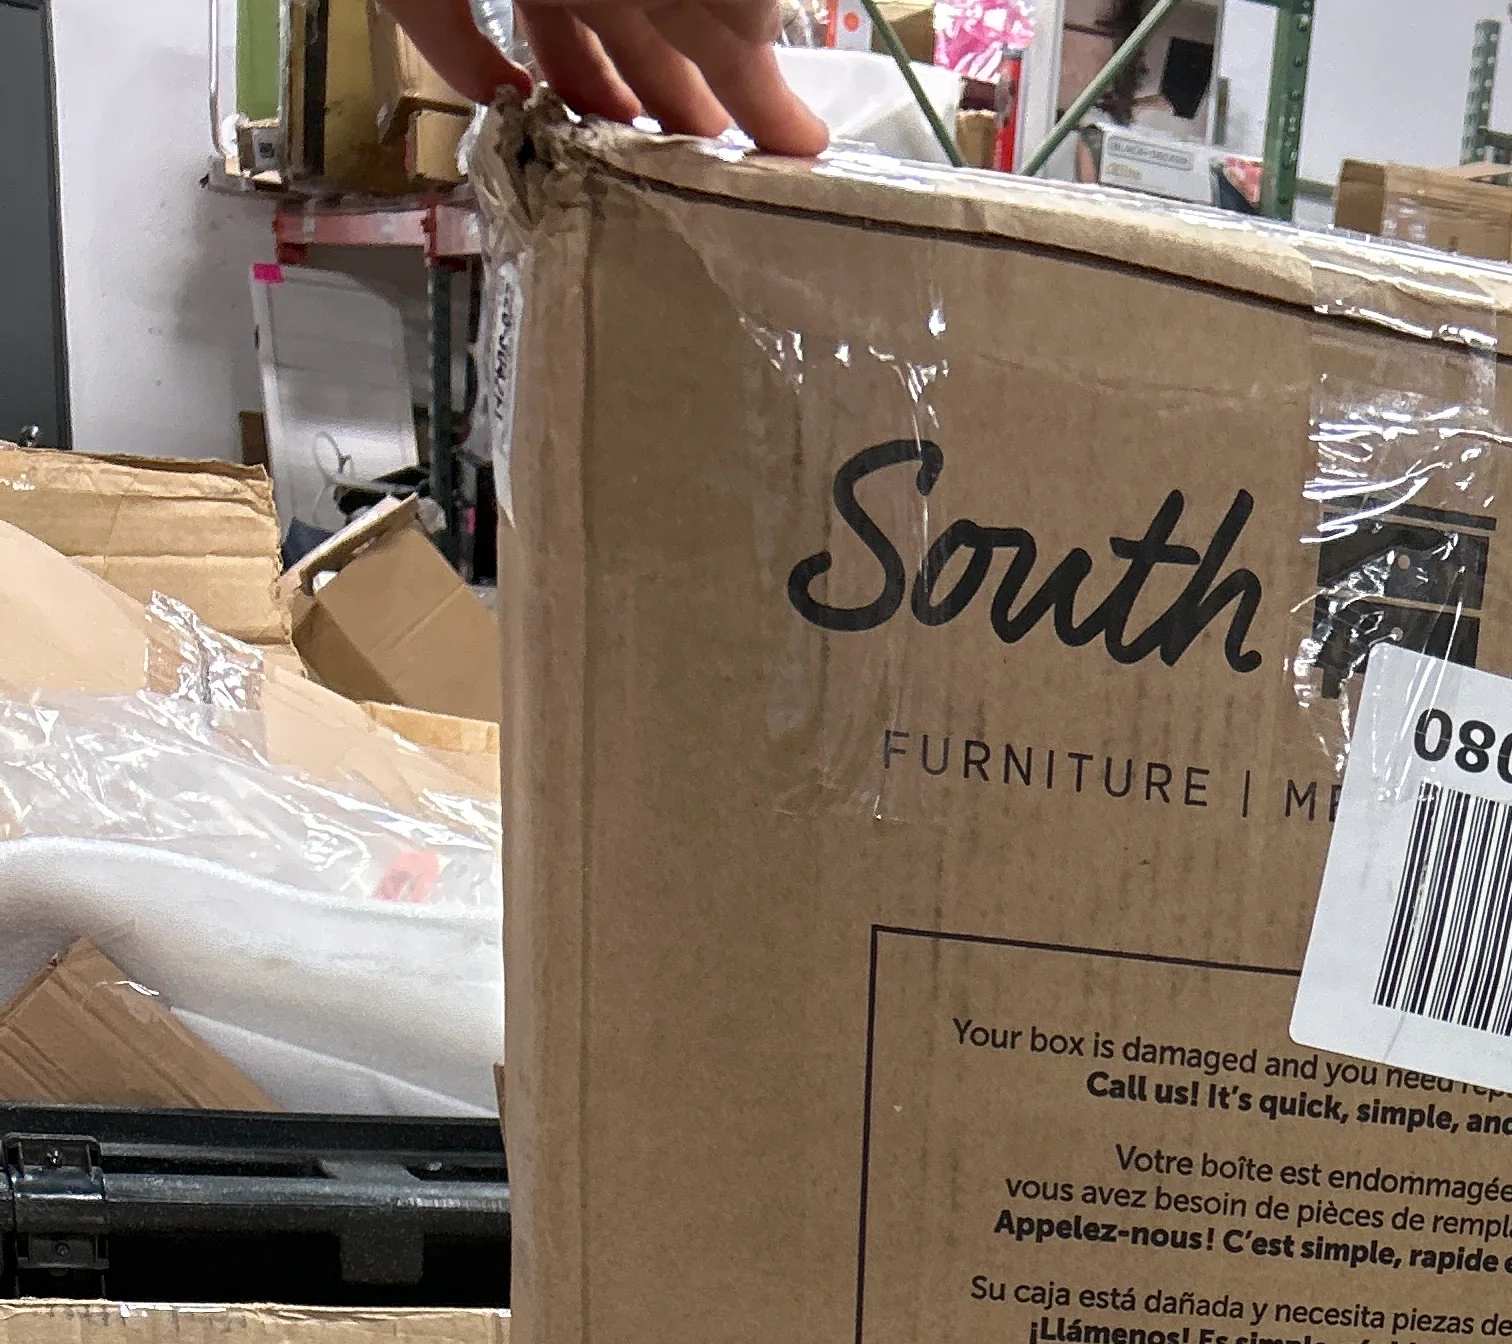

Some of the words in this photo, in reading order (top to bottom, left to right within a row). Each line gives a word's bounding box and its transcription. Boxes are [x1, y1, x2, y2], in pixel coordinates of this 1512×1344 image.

[786, 440, 1263, 675] South
[884, 730, 1210, 806] FURNITURE
[953, 1017, 1022, 1049] Your
[1030, 1025, 1084, 1056] box
[1093, 1031, 1114, 1058] is
[1122, 1035, 1257, 1075] damaged
[1264, 1049, 1318, 1080] and
[1324, 1061, 1377, 1088] you
[1086, 1071, 1147, 1101] Call
[1155, 1080, 1199, 1106] us!
[1208, 1083, 1252, 1111] It's
[1259, 1091, 1348, 1124] quick,
[1356, 1098, 1459, 1133] simple,
[1115, 1143, 1193, 1175] Votre
[1201, 1152, 1273, 1182] boîte
[1279, 1163, 1322, 1186] est
[1004, 1180, 1072, 1203] vous
[1081, 1187, 1146, 1208] avez
[1154, 1186, 1246, 1216] besoin
[1255, 1194, 1289, 1220] de
[1296, 1199, 1383, 1228] pièces
[1391, 1206, 1424, 1231] de
[993, 1209, 1214, 1250] Appelez-nous!
[1222, 1229, 1294, 1257] C'est
[1300, 1235, 1401, 1268] simple,
[1409, 1246, 1498, 1274] rapide
[970, 1275, 1005, 1301] Su
[1014, 1281, 1070, 1310] caja
[1078, 1287, 1135, 1310] está
[1144, 1289, 1243, 1318] dañada
[1249, 1302, 1268, 1325] y
[1275, 1303, 1384, 1328] necesita
[1391, 1307, 1474, 1335] piezas
[1481, 1312, 1512, 1336] de
